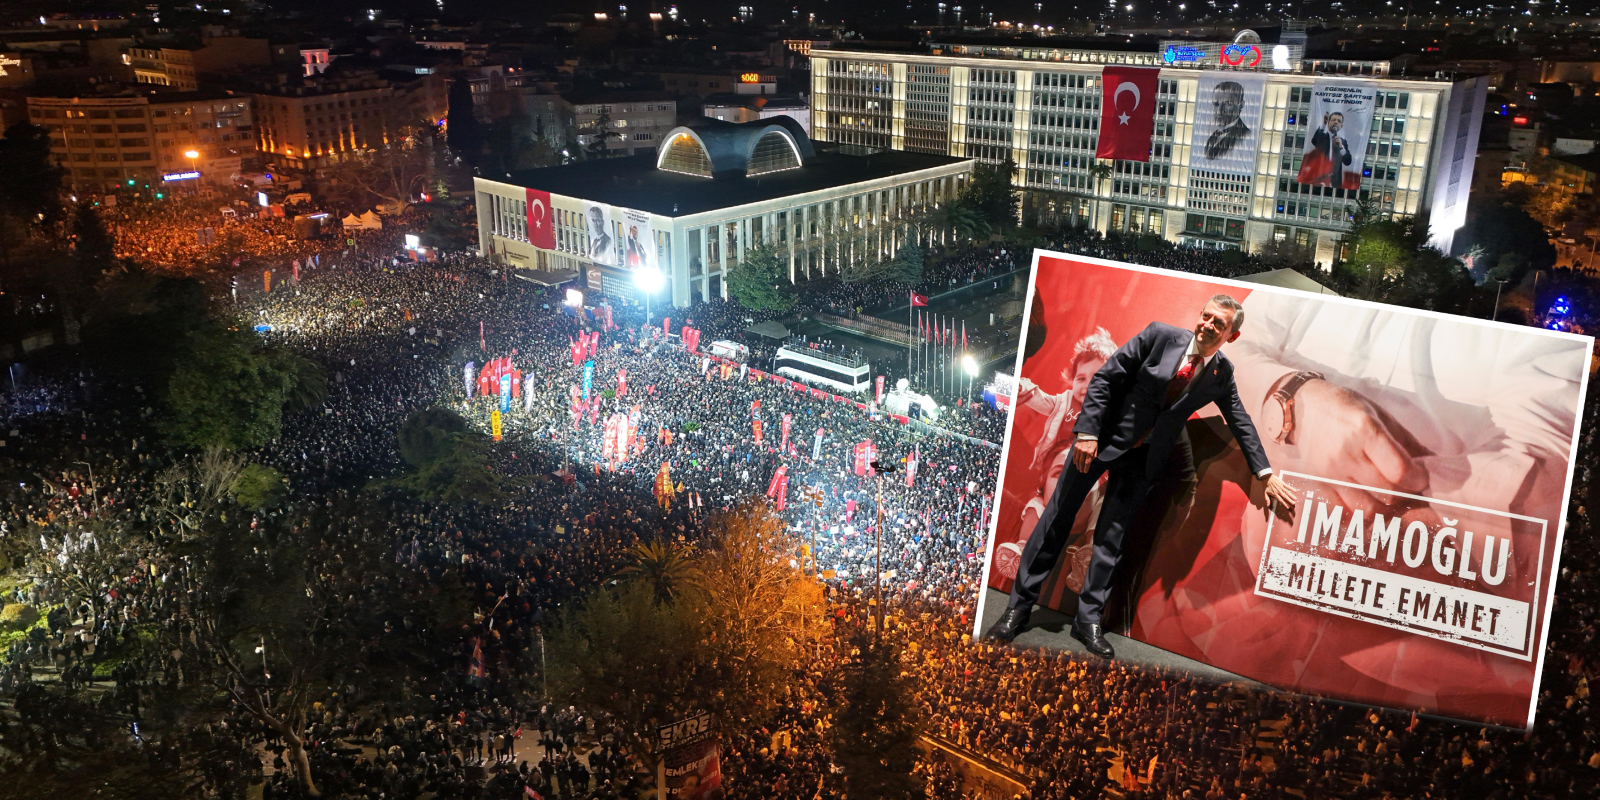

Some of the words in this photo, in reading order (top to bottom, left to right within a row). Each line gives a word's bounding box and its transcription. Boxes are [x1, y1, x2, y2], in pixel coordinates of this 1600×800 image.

[1325, 86, 1363, 94] EGEMENLİK
[1343, 93, 1373, 101] ŞARTSIZ
[1297, 490, 1511, 586] İMAMOĞLU
[1287, 560, 1387, 609] MİLLETE
[1397, 587, 1502, 636] EMANET
